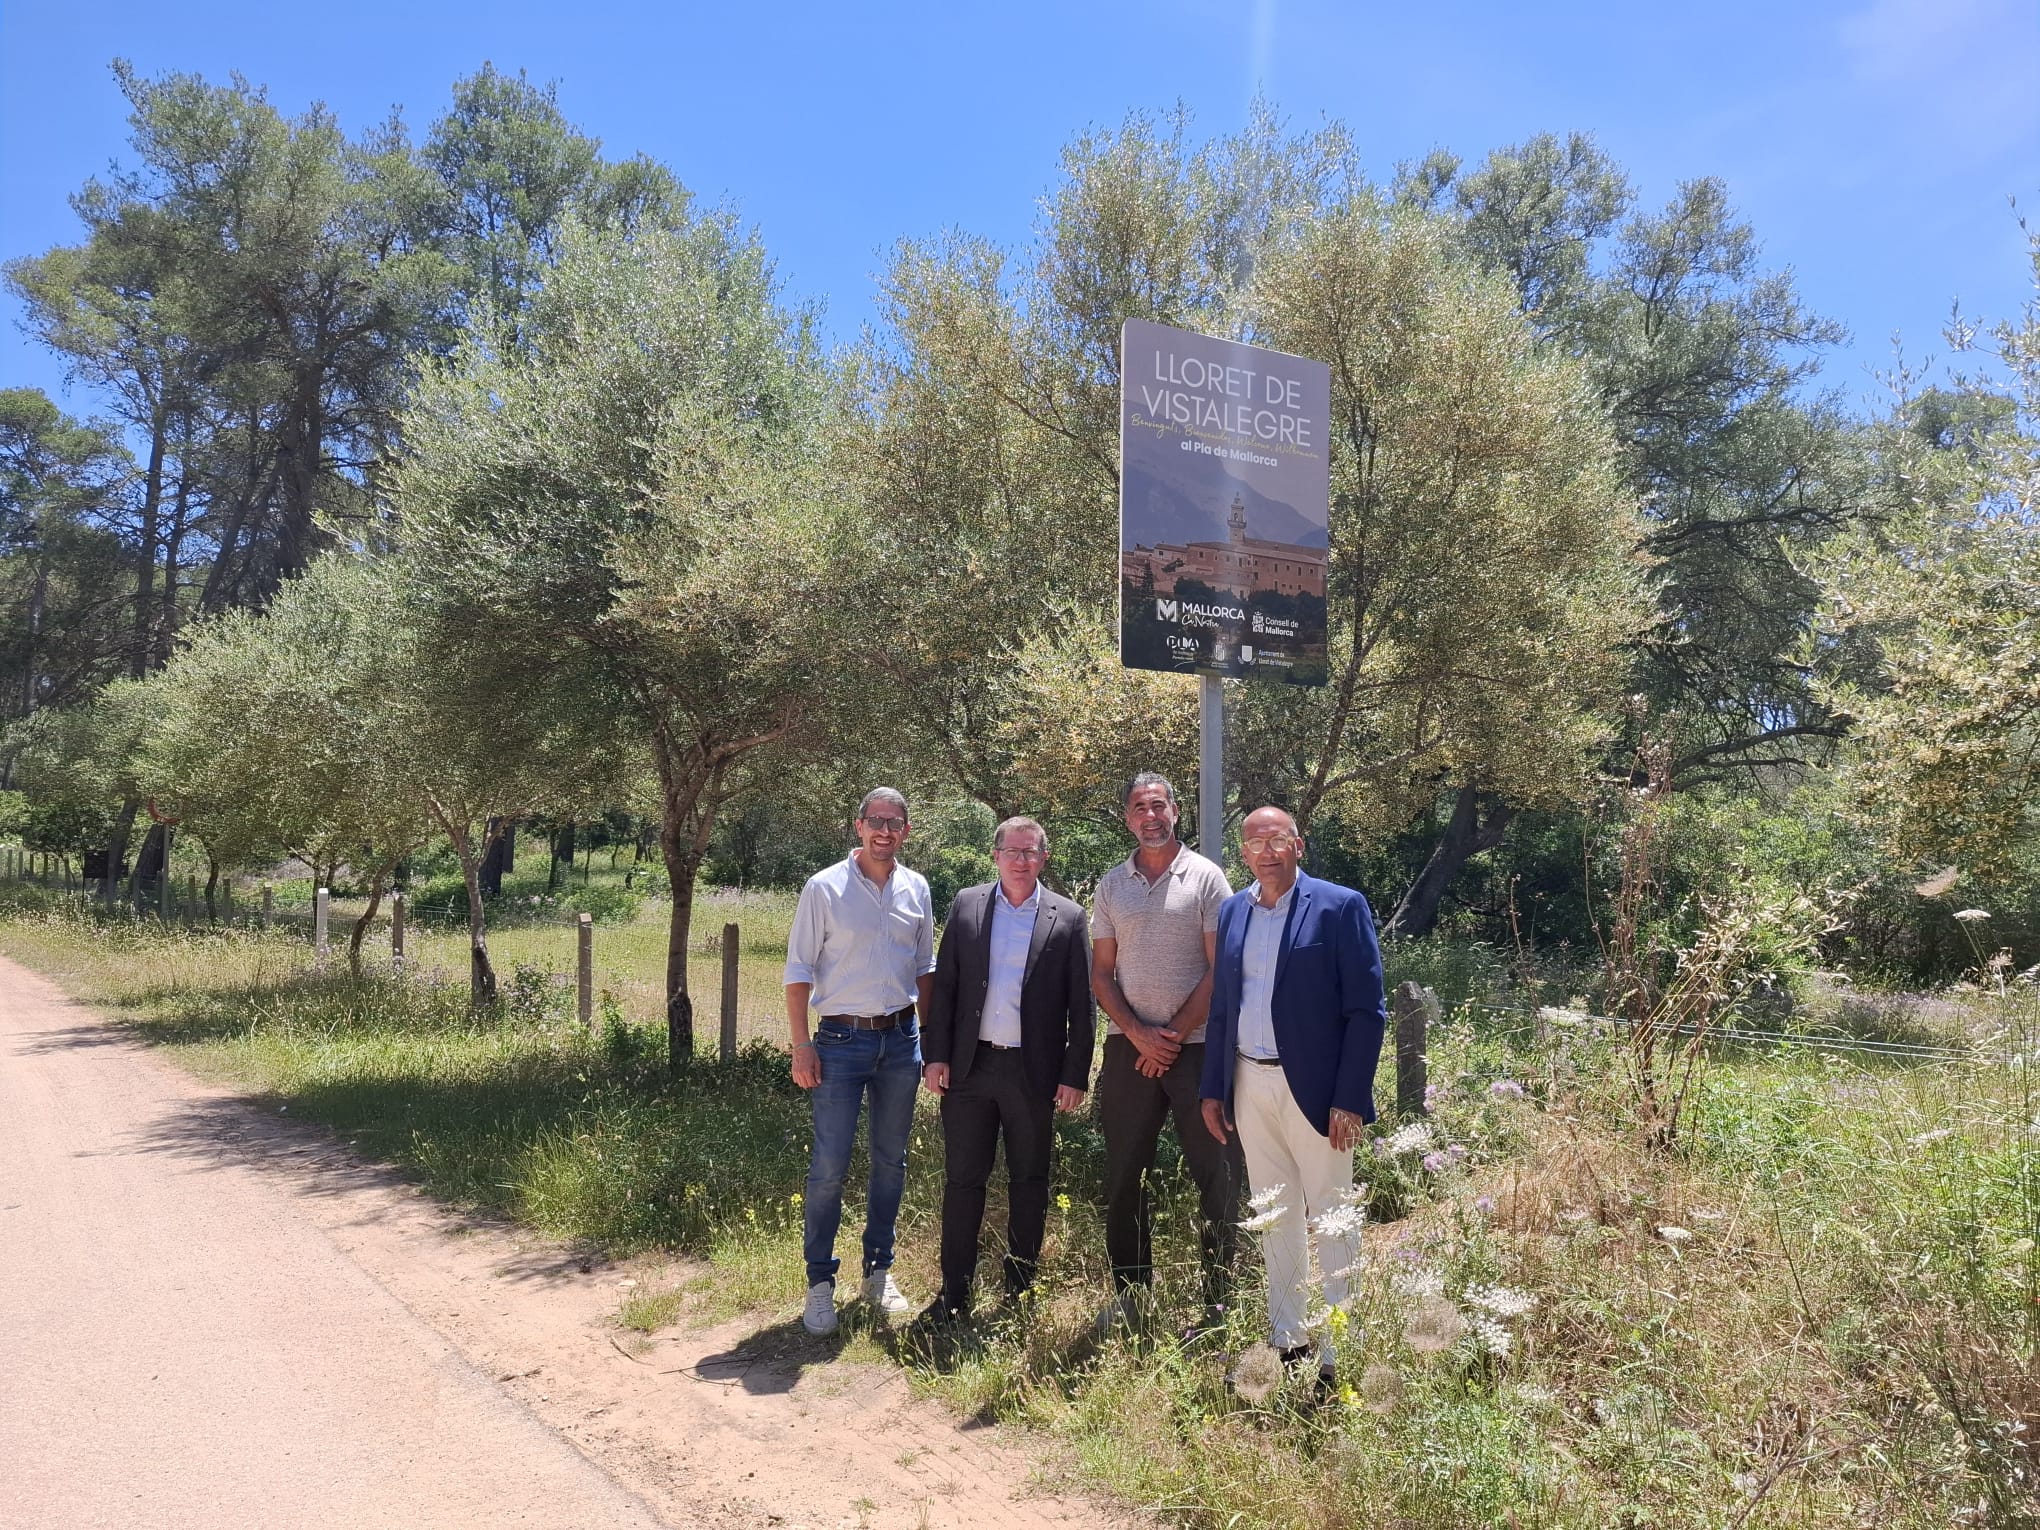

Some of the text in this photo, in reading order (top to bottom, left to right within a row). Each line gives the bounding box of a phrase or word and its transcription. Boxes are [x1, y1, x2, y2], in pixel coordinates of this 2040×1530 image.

[1155, 350, 1301, 409] LLORET DE
[1142, 385, 1311, 447] VISTALEGRE
[1181, 440, 1278, 467] al Pla de Mallorca
[1182, 602, 1245, 620] MALLORCA
[1265, 617, 1299, 628] Consell de
[1265, 626, 1294, 636] Mallorca
